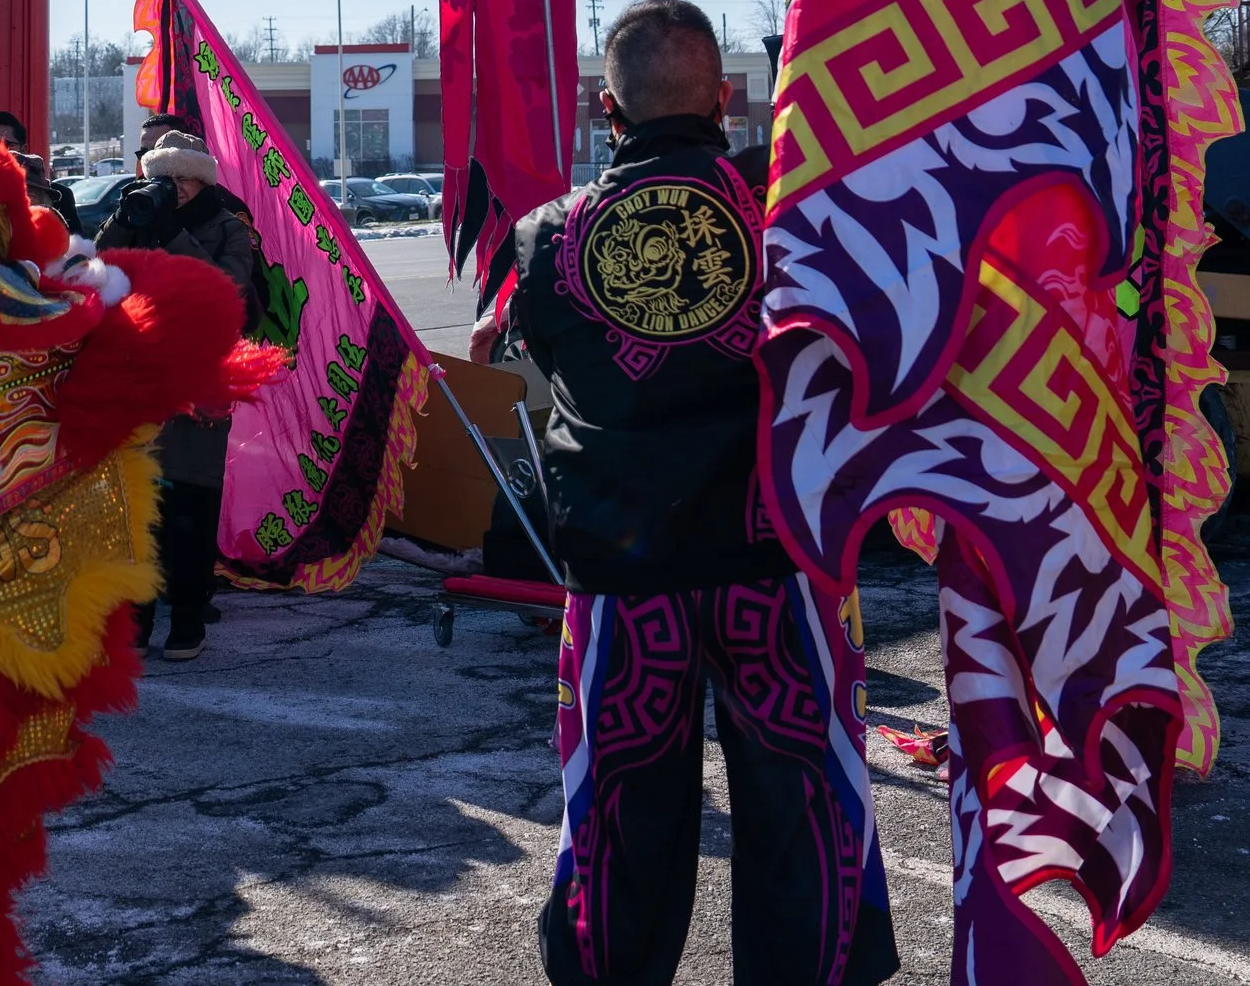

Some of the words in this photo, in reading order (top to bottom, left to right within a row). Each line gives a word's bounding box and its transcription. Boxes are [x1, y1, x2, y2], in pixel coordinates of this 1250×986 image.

[345, 67, 380, 89] AAA
[615, 191, 651, 220] CHOY
[657, 189, 690, 208] WUN
[678, 204, 733, 290] 採雲
[641, 312, 674, 332] LION
[678, 297, 726, 330] DANCE
